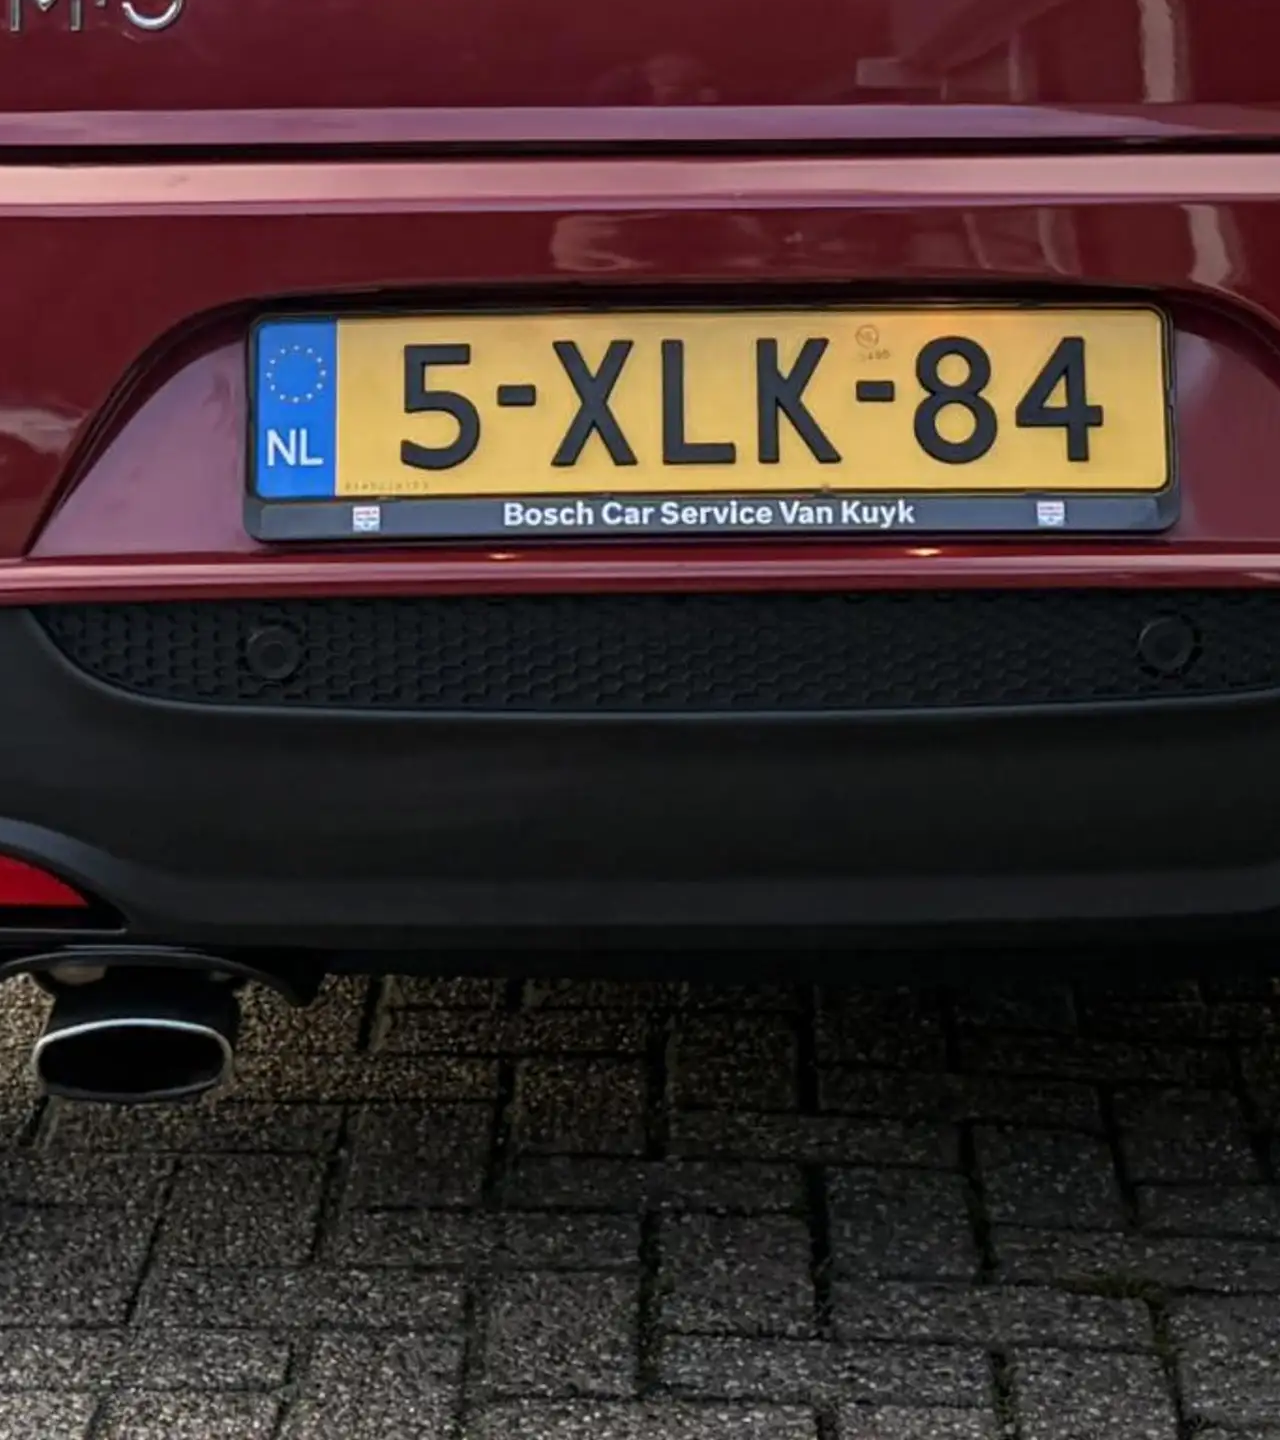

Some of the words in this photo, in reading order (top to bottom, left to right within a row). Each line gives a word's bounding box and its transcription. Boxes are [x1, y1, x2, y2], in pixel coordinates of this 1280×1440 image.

[400, 336, 1104, 471] 5-XLK-84
[267, 428, 325, 467] NL
[503, 501, 594, 527] Bosch
[601, 502, 655, 526] Car
[660, 500, 773, 526] Service
[779, 500, 833, 525] Van
[840, 500, 916, 529] Kuyk
